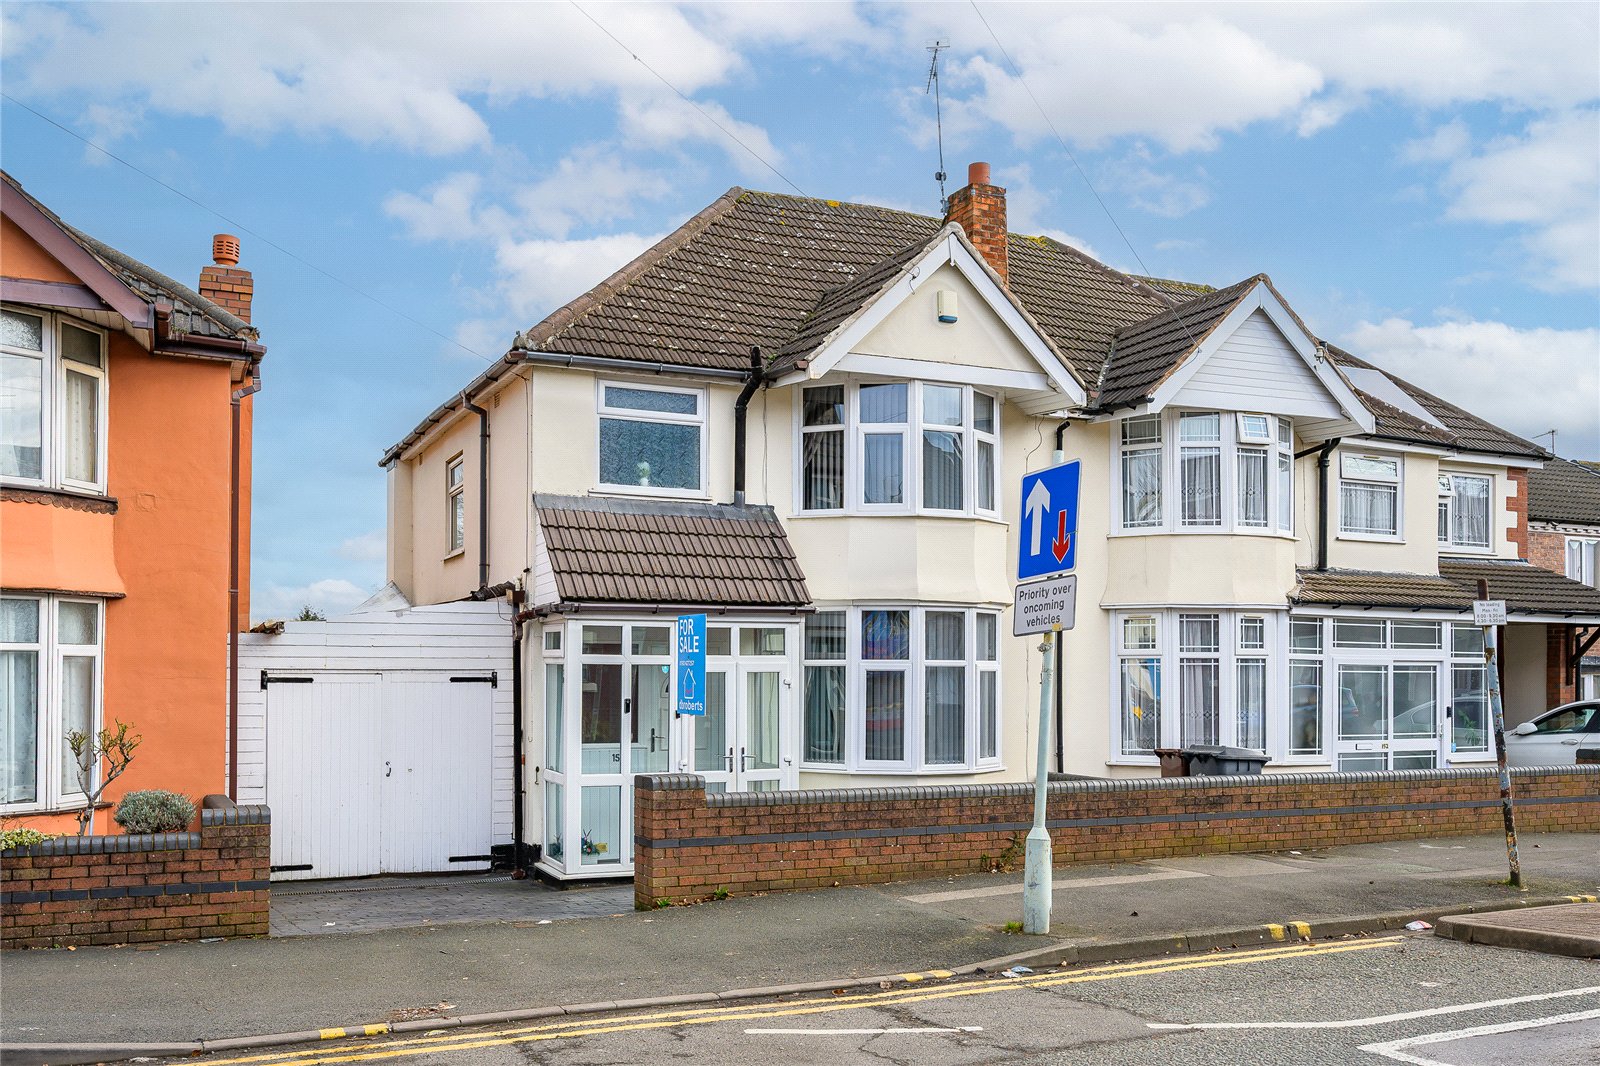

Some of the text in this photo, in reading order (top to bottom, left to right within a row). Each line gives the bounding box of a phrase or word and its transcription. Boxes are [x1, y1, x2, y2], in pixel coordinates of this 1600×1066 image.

[1019, 584, 1071, 601] Priority over
[1023, 599, 1065, 614] oncoming
[680, 618, 694, 636] FOR
[1026, 613, 1061, 627] vehicles
[680, 635, 700, 653] SALE
